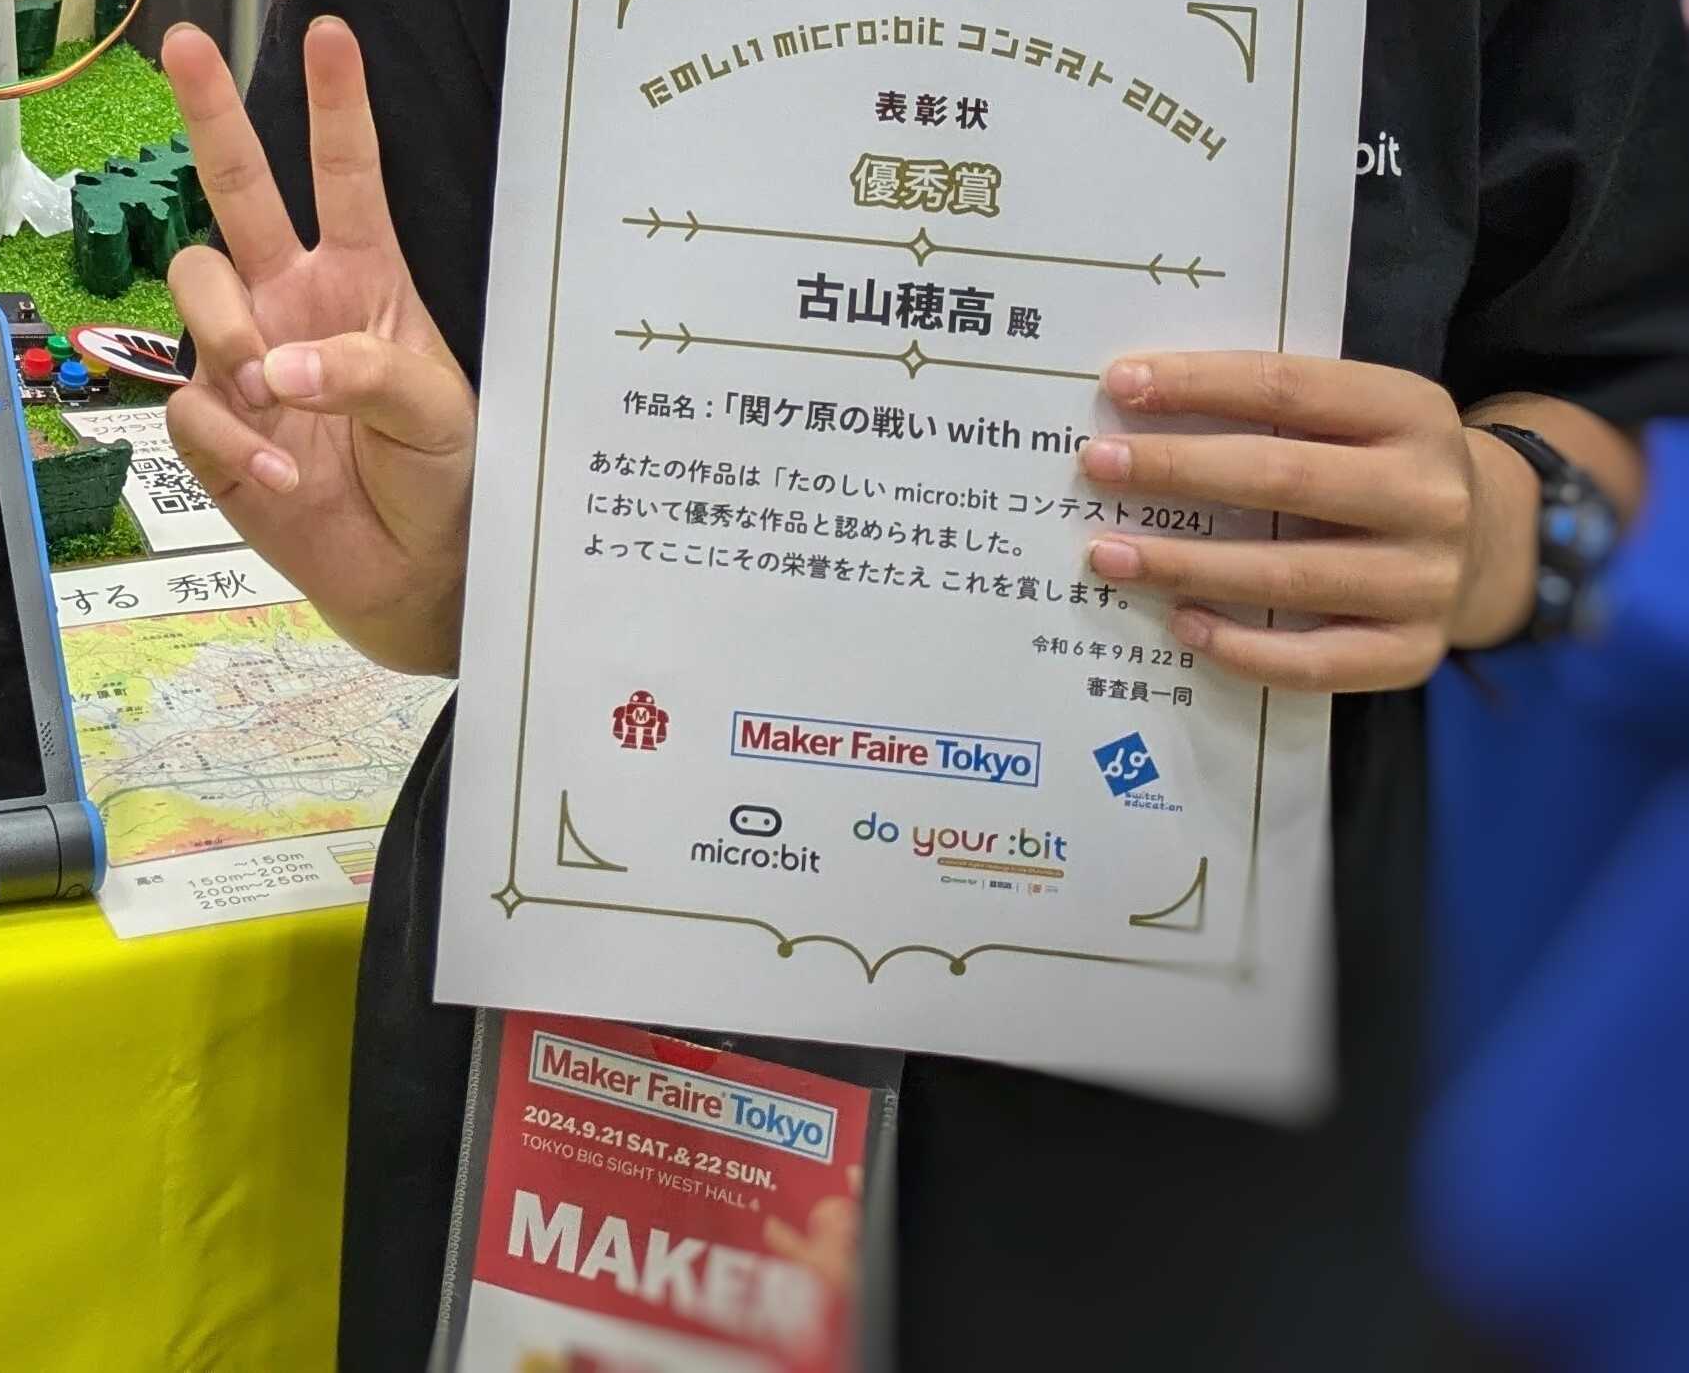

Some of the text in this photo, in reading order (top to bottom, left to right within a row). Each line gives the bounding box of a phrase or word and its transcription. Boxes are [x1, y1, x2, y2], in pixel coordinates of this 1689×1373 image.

[773, 16, 945, 58] micro:bit
[958, 23, 1113, 88] コンテスト
[1121, 78, 1227, 161] 2024
[875, 90, 989, 131] 表彰状
[852, 154, 1000, 217] 優秀賞
[947, 416, 1021, 449] with
[587, 493, 1024, 558] において優秀な作品と認められました。
[894, 482, 999, 512] micro:bit
[1008, 493, 1130, 525] コンテスト
[167, 569, 257, 604] 秀秋
[1086, 676, 1193, 707] 審査員一同
[740, 719, 1031, 782] Maker Faire Tokyo
[691, 838, 821, 874] micro:bit
[853, 811, 1068, 862] do your :bit
[542, 1045, 824, 1148] Maker Faire Tokyo
[520, 1132, 575, 1160] TOKYO
[576, 1147, 605, 1168] BIG
[607, 1156, 656, 1182] SIGHT
[657, 1170, 704, 1195] WEST
[705, 1183, 745, 1210] HALL
[522, 1105, 623, 1147] 2024.9.21
[693, 1150, 723, 1176] 22
[726, 1160, 777, 1192] SUN.
